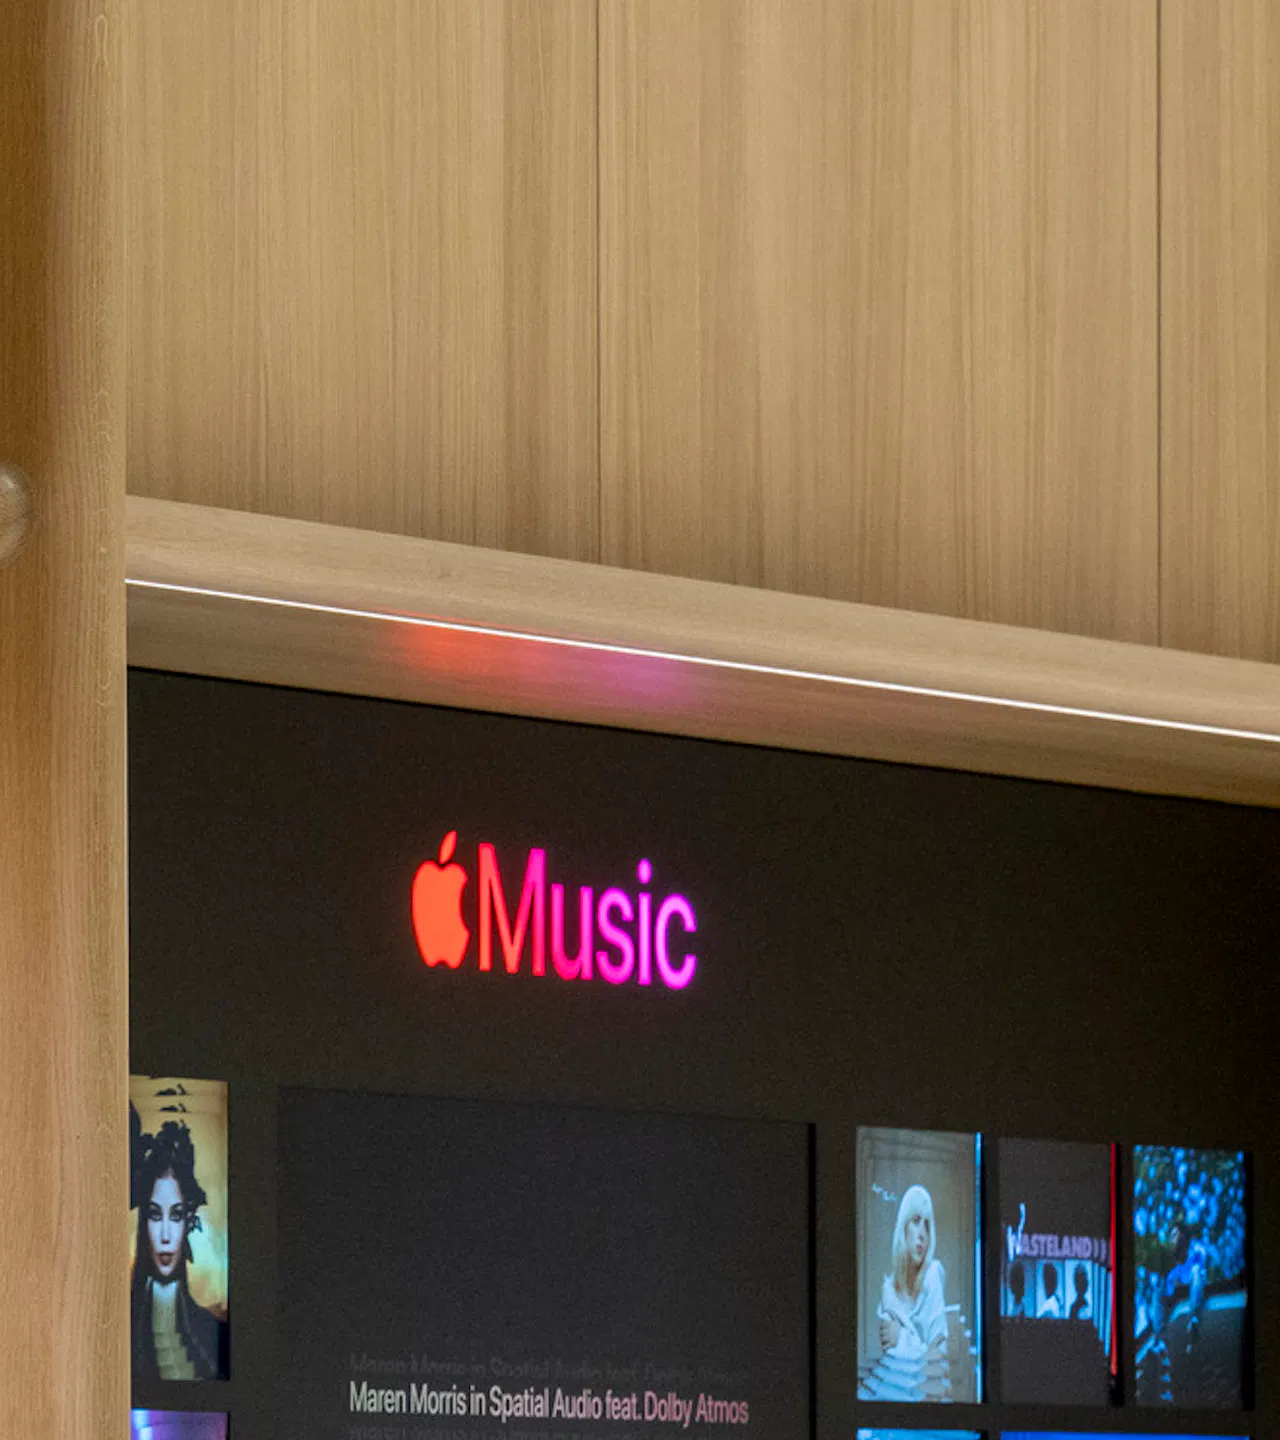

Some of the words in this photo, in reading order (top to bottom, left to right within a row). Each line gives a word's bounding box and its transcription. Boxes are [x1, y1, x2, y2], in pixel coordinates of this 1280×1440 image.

[477, 842, 697, 990] Music
[1006, 1202, 1093, 1262] WASTELAND
[349, 1380, 406, 1413] Maren
[409, 1382, 467, 1416] Morris
[469, 1384, 486, 1416] in
[489, 1385, 550, 1423] Spatial
[551, 1387, 602, 1420] Audio
[604, 1388, 644, 1421] feat.
[644, 1390, 693, 1428] Dolby
[695, 1392, 749, 1425] Atmos
